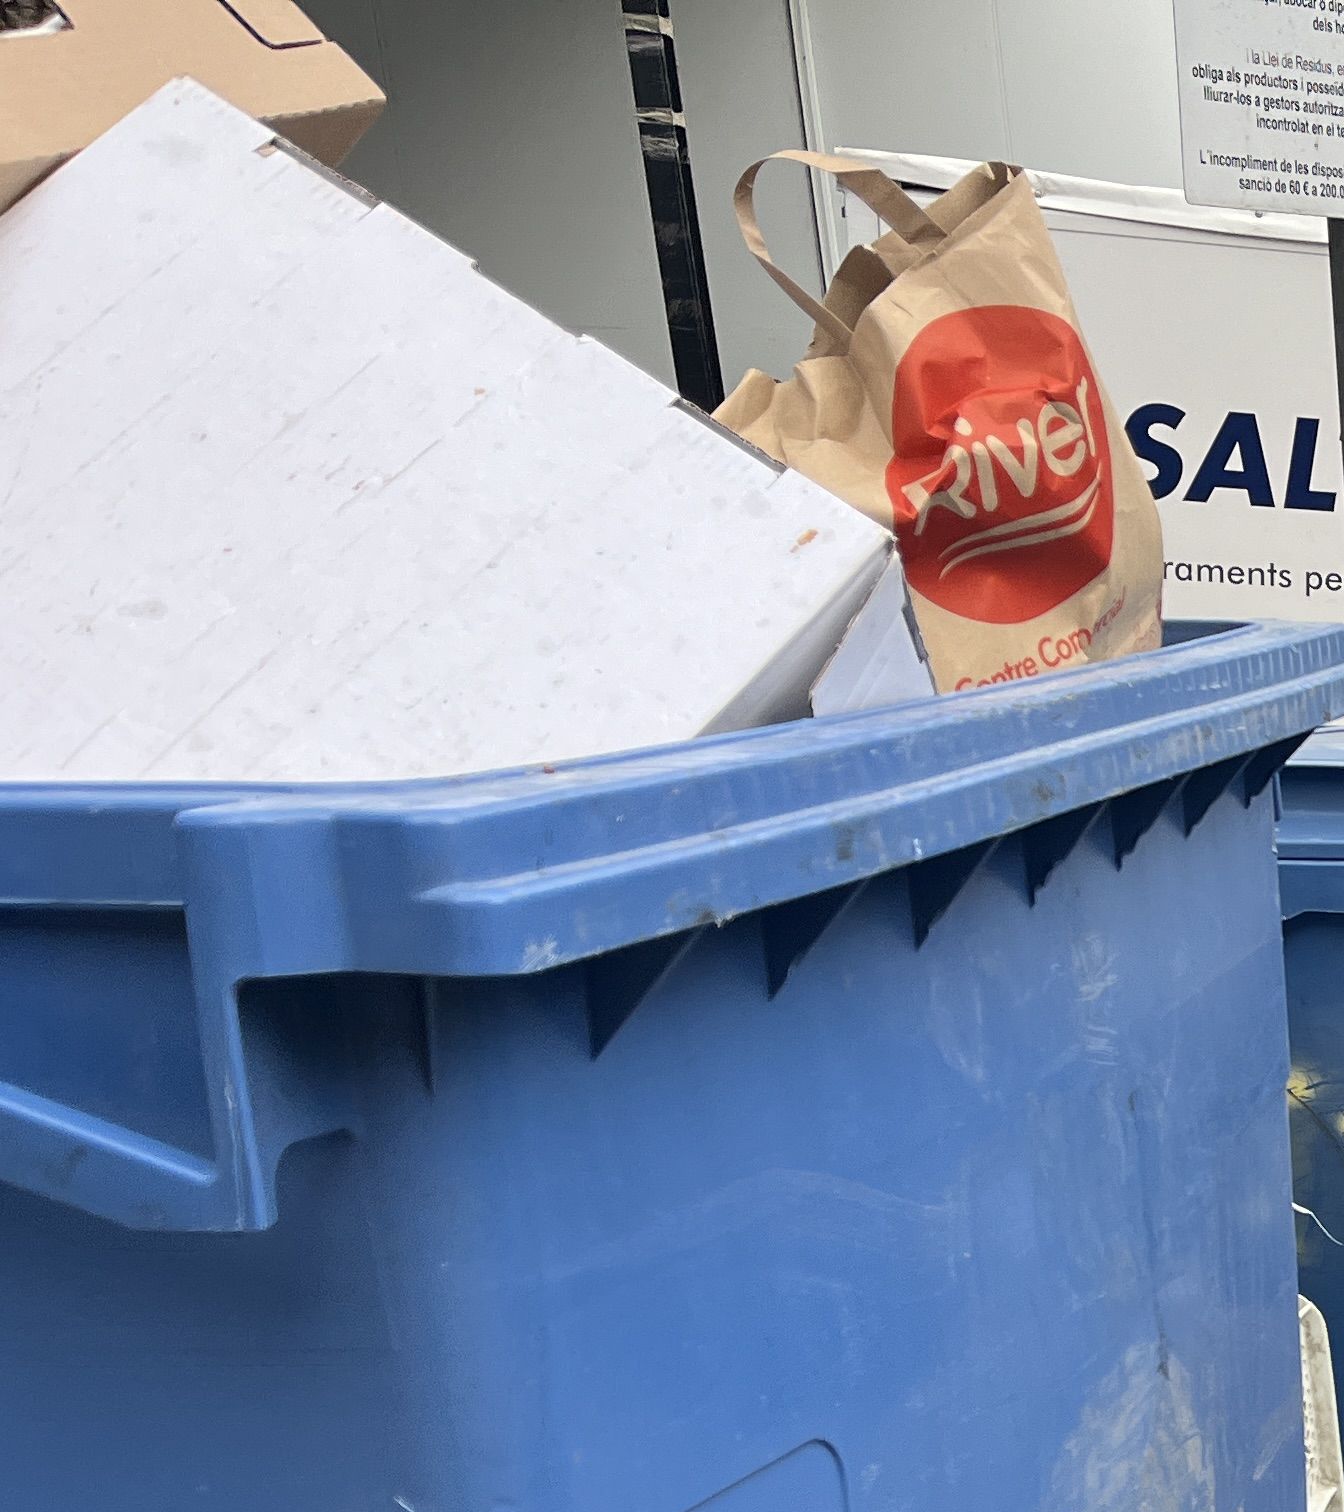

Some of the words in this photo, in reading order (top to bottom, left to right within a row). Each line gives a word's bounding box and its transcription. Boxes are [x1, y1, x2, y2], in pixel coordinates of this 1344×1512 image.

[1313, 16, 1333, 32] dels
[1251, 48, 1260, 65] la
[1263, 50, 1279, 67] Llei
[1281, 52, 1293, 69] de
[1295, 54, 1335, 75] Residus,
[1192, 63, 1224, 83] obliga
[1226, 67, 1241, 83] als
[1244, 72, 1298, 91] productors
[1203, 85, 1252, 106] lliurar-los
[1255, 95, 1261, 107] a
[1263, 97, 1300, 112] gestors
[1256, 113, 1309, 134] incontrolat
[1312, 122, 1323, 135] en
[1326, 123, 1335, 137] el
[1280, 158, 1292, 173] de
[1294, 160, 1309, 175] les
[1239, 176, 1272, 191] sanció
[1275, 178, 1286, 193] de
[1303, 181, 1310, 196] €
[1312, 186, 1317, 196] a
